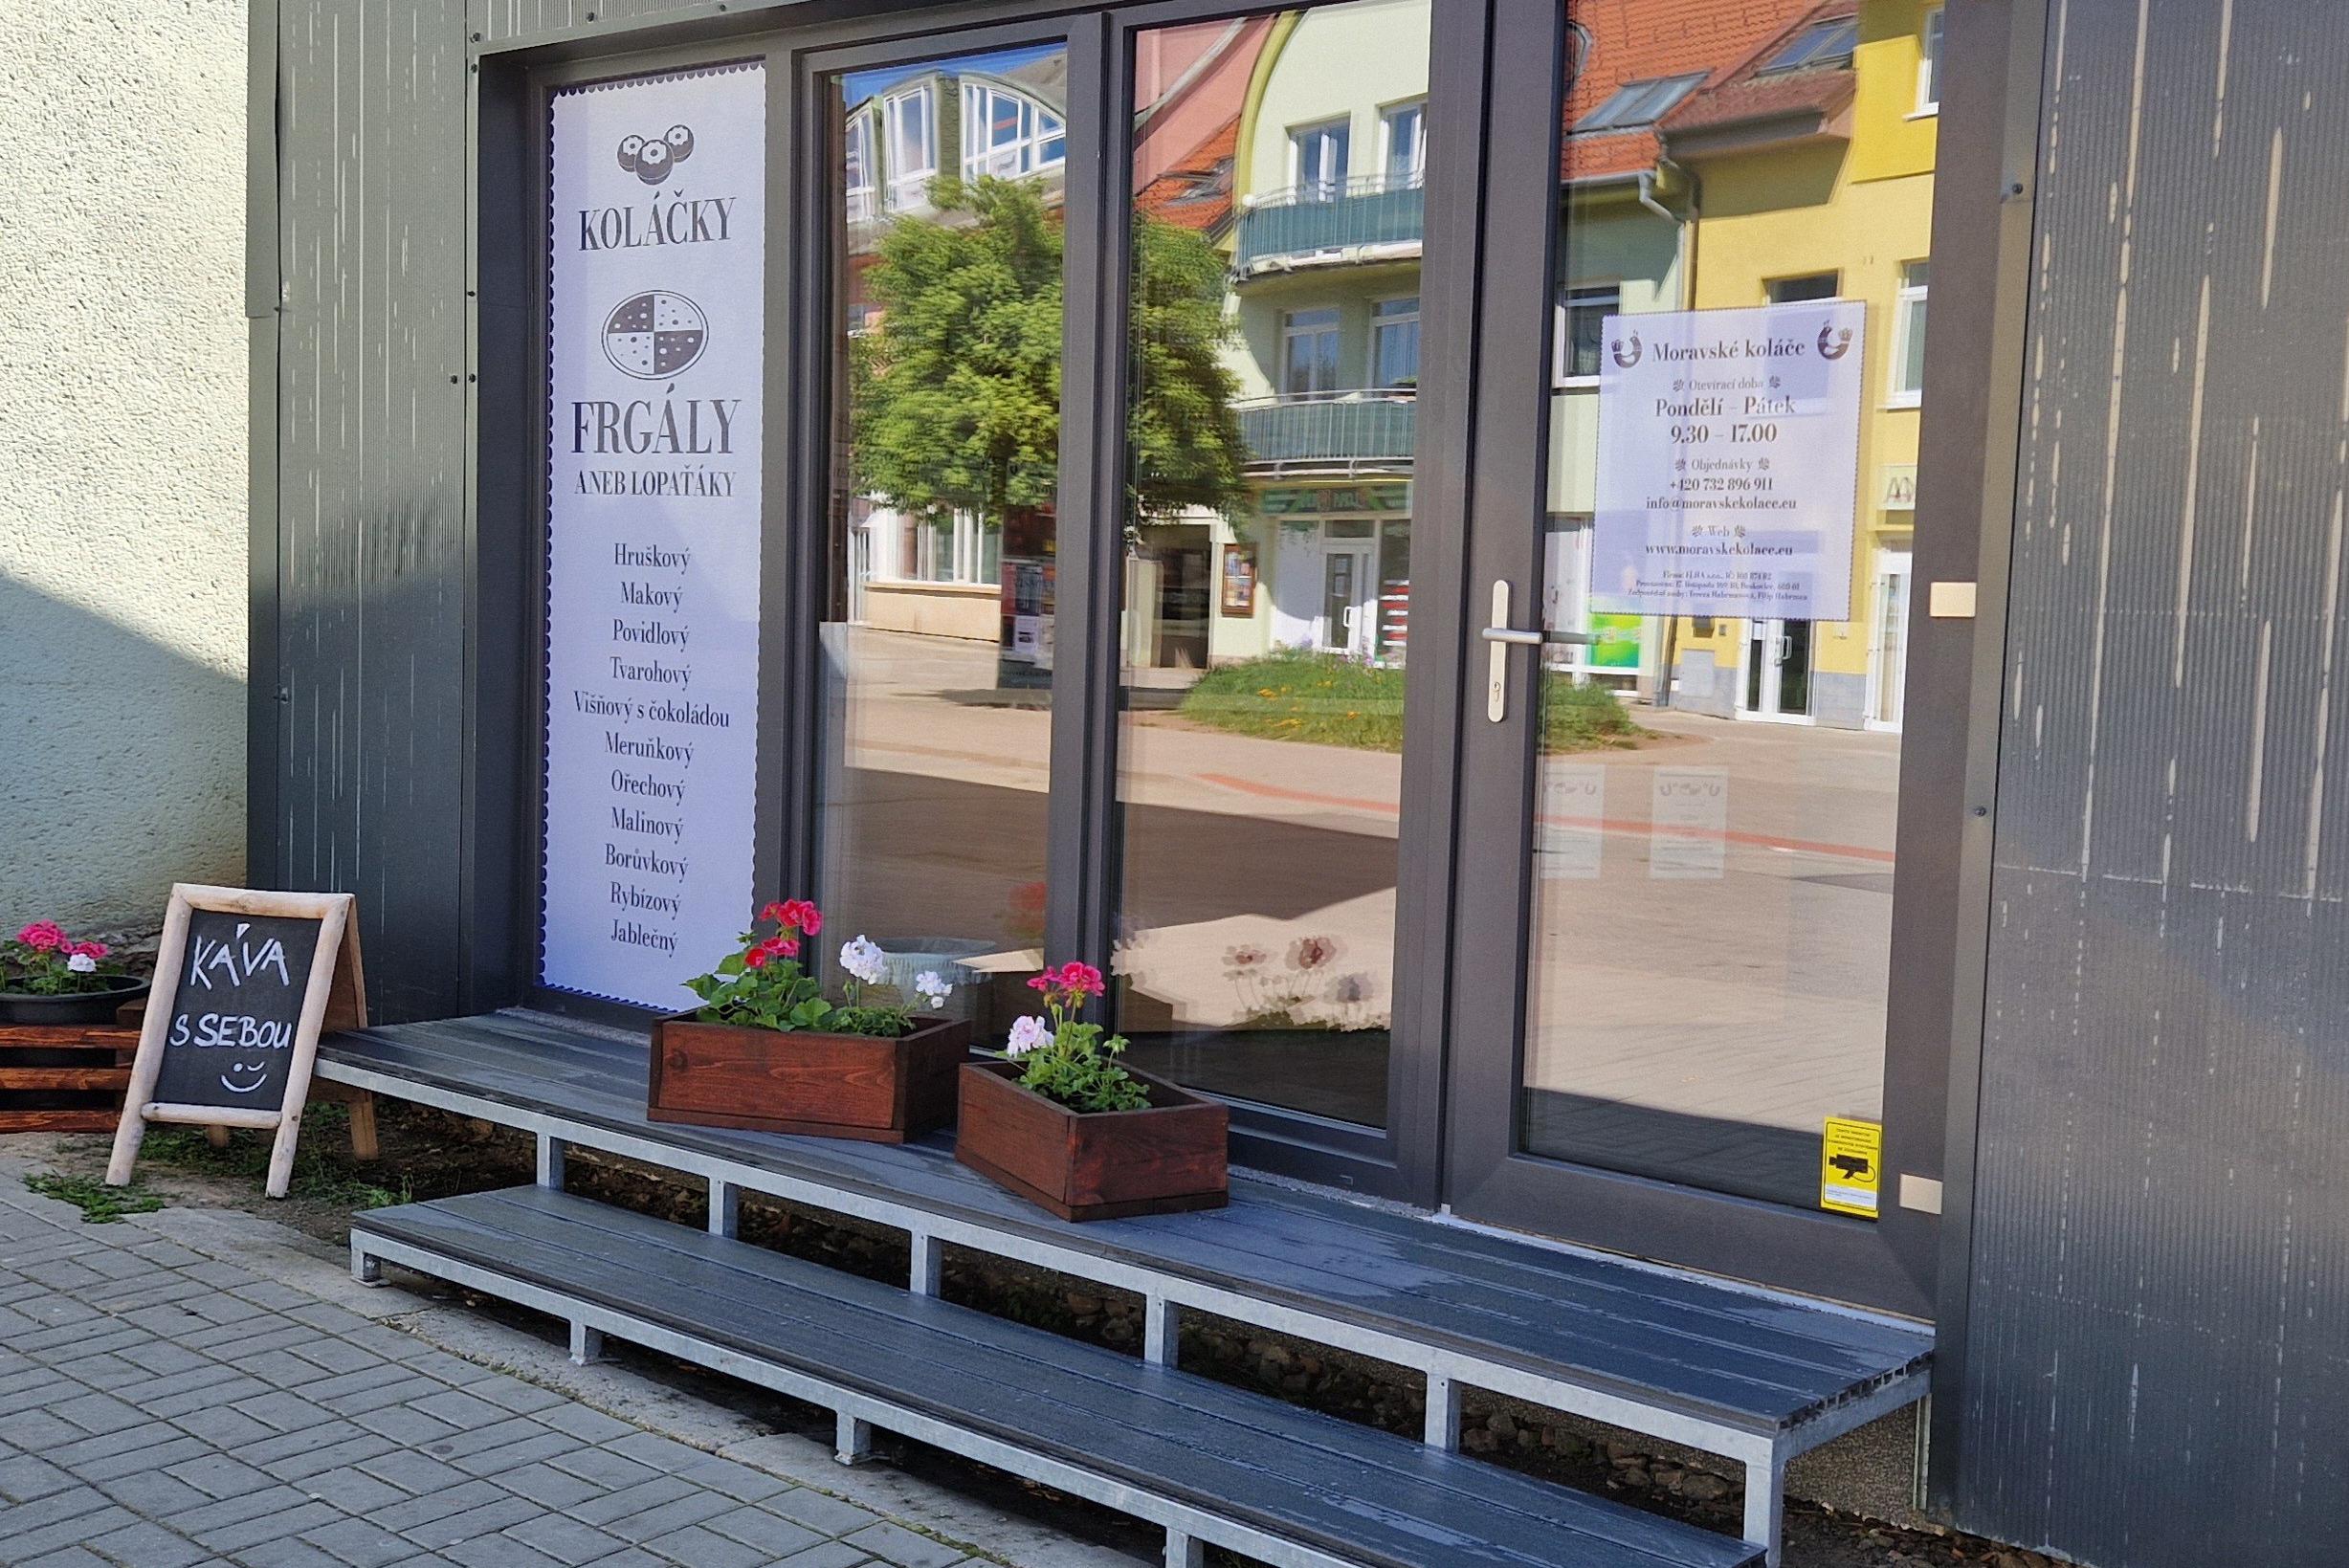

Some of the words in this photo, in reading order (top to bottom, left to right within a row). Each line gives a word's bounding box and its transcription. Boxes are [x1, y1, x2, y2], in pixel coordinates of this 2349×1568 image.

[578, 188, 737, 251] KOLÁČKY
[1652, 342, 1740, 362] Moravské
[1744, 338, 1806, 357] koláče
[1739, 377, 1763, 389] doba
[571, 383, 742, 454] FRGÁLY
[1655, 397, 1723, 417] Pondělí
[1744, 396, 1797, 414] Pátek
[1671, 425, 1709, 444] 9.30
[1731, 424, 1778, 443] 17.00
[574, 470, 626, 496] ANEB
[631, 465, 737, 497] LOPAŤÁKY
[1692, 457, 1753, 474] Objednávky
[1671, 478, 1699, 492] +420
[1704, 478, 1724, 491] 732
[1728, 478, 1751, 491] 896
[1754, 477, 1773, 491] 911
[1708, 525, 1730, 538] Web
[612, 542, 691, 575] Hruškový
[620, 582, 683, 613] Makový
[612, 619, 690, 652] Povidlový
[610, 656, 691, 692] Tvarohový
[574, 691, 633, 724] Višňový
[636, 704, 645, 719] s
[649, 699, 730, 727] čokoládou
[605, 731, 694, 768] Meruňkový
[610, 769, 685, 806] Ořechový
[610, 806, 684, 844] Malinový
[605, 843, 689, 883] Borůvkový
[610, 881, 681, 920] Rybízový
[610, 918, 679, 958] Jablečný
[189, 922, 290, 990] KÁVA
